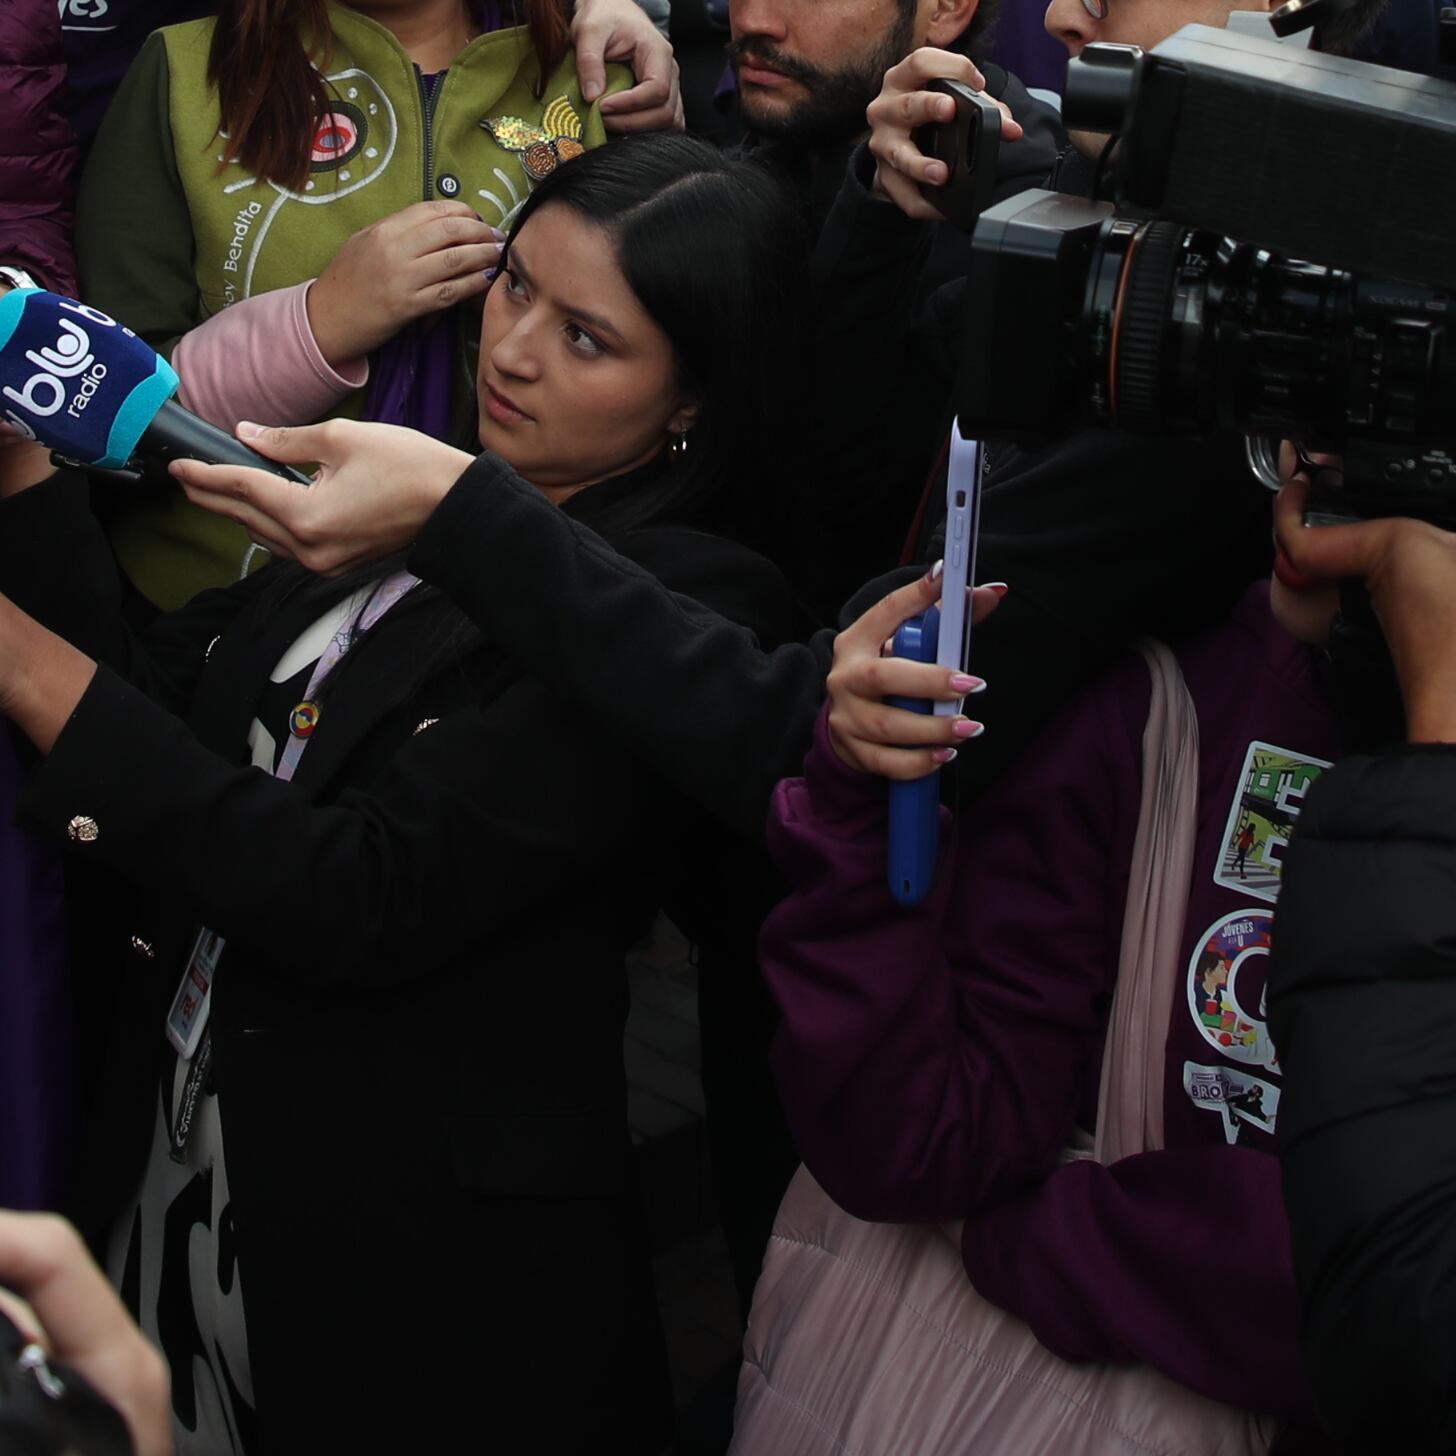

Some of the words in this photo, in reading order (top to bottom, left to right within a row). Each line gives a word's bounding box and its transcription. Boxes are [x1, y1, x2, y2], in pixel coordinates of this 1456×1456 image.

[224, 201, 262, 273] Bendita
[2, 316, 96, 418] blu
[67, 362, 109, 420] radio
